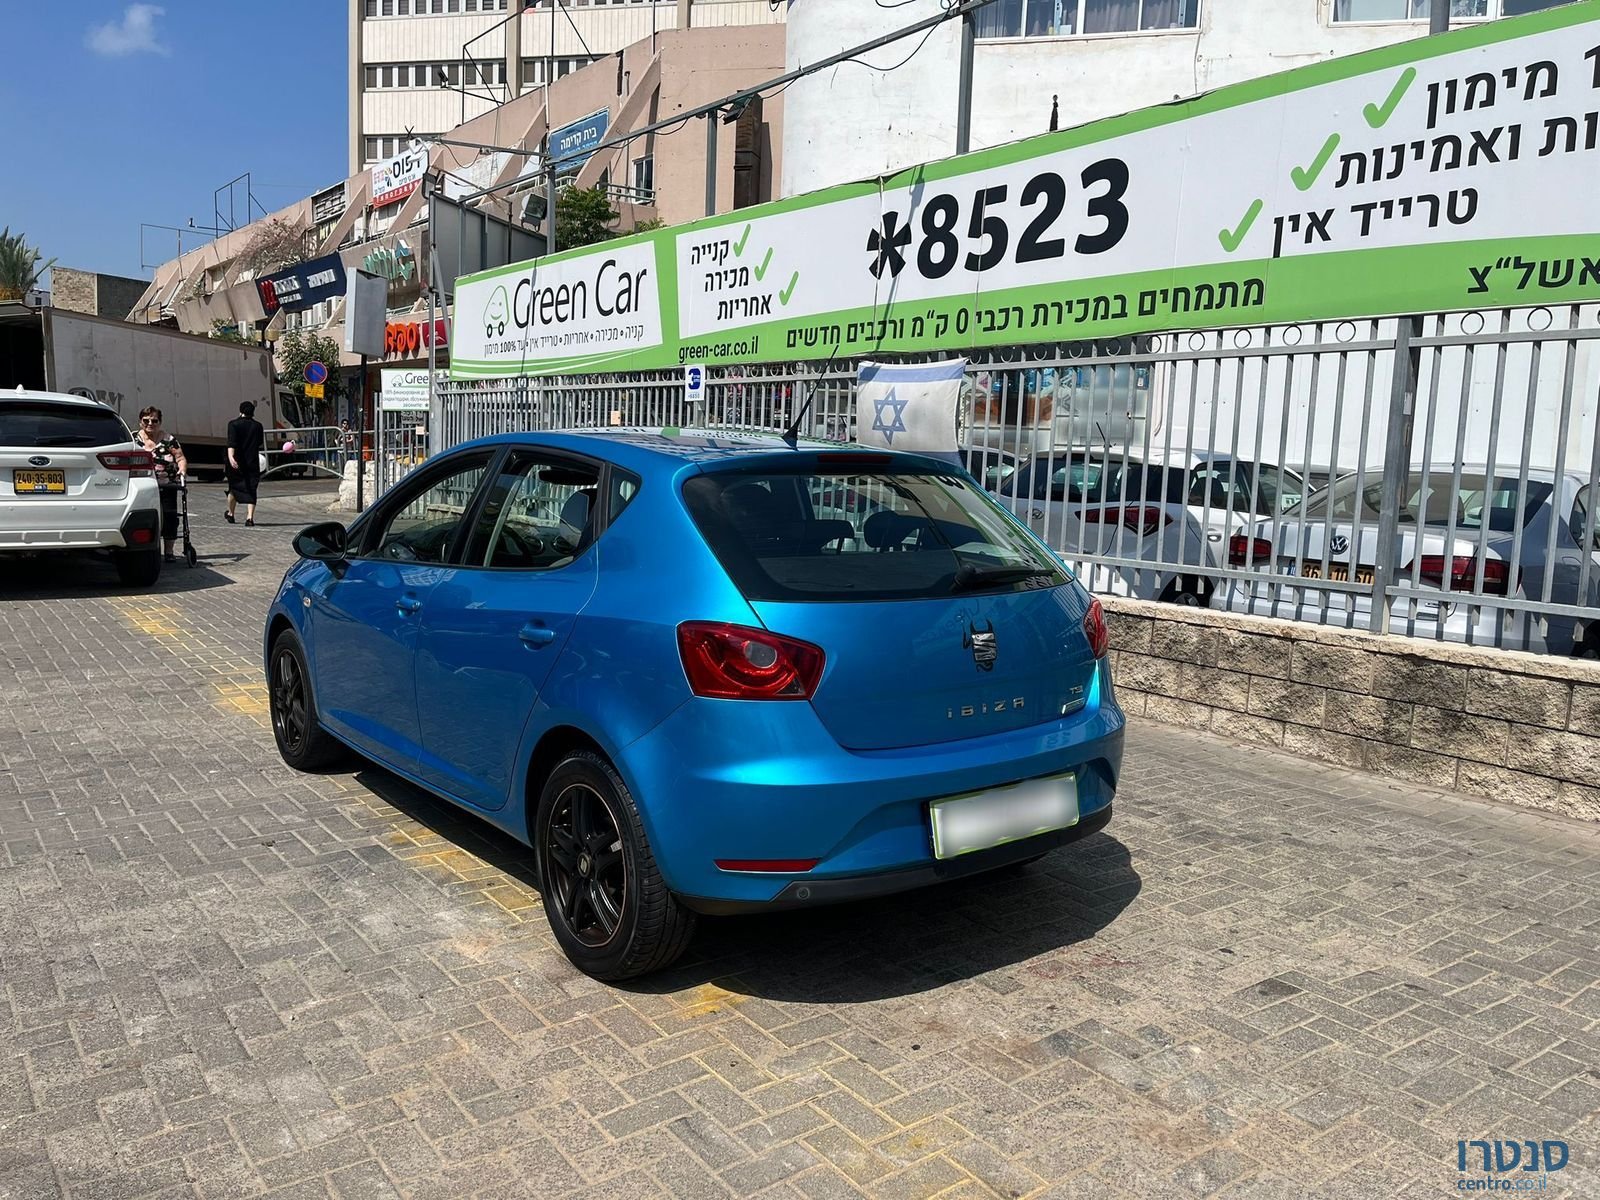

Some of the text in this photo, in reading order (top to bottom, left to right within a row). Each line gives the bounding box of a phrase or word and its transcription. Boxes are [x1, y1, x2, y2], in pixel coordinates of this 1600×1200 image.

[1426, 60, 1558, 129] מימון
[1335, 123, 1522, 188] ואמינות
[1272, 186, 1479, 258] טרייד אין
[691, 240, 730, 266] קנייה
[704, 266, 749, 292] מכירה
[513, 259, 648, 329] Green Car
[717, 294, 773, 321] אחריות
[1138, 277, 1264, 317] מתמחים
[955, 307, 970, 335] 0
[974, 304, 1024, 334] רכבי
[1030, 293, 1128, 328] במכירת
[540, 334, 558, 348] טרייד
[563, 330, 589, 346] אחריות
[595, 327, 619, 342] מכירה
[625, 324, 644, 342] קניה
[786, 324, 841, 349] חדשים
[846, 317, 905, 344] ורכבים
[500, 342, 516, 353] 100%
[679, 335, 759, 363] green-car.co.il
[405, 372, 429, 385] Gree
